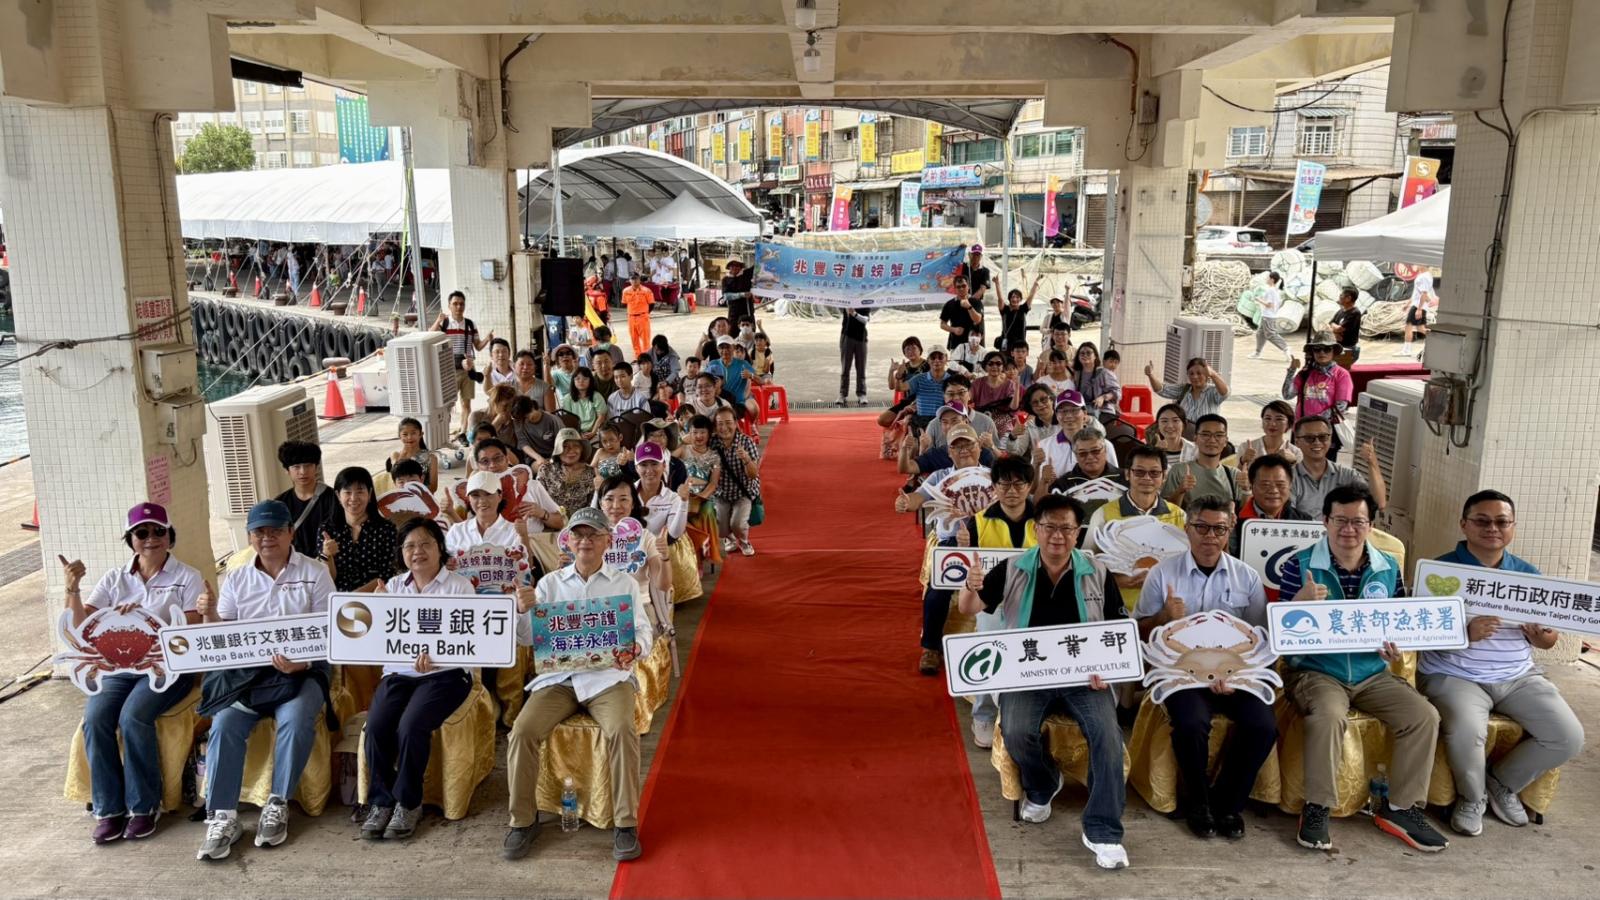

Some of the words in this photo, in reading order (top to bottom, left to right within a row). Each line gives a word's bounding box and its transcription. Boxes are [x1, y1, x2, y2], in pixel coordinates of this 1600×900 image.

[794, 259, 922, 279] 兆豐守護螃蟹日
[459, 555, 514, 569] 送螃蟹媽媽
[605, 552, 628, 564] 相挺
[479, 569, 517, 583] 回娘家
[385, 607, 509, 635] 兆豐銀行
[549, 610, 617, 632] 兆豐守護
[1327, 606, 1456, 635] 農業部漁業署
[1464, 598, 1502, 610] Agriculture
[1549, 611, 1571, 621] Taipei
[1572, 613, 1587, 625] City
[386, 638, 429, 658] Mega
[436, 640, 476, 656] Bank
[552, 631, 620, 652] 海洋永續
[1018, 631, 1127, 663] 農業部
[1422, 634, 1458, 642] Agriculture
[200, 654, 227, 664] Mega
[230, 651, 255, 660] Bank
[283, 643, 327, 655] Foundati
[1020, 667, 1059, 679] MINISTRY
[1060, 666, 1071, 675] OF
[1074, 661, 1131, 675] AGRICULTURE
